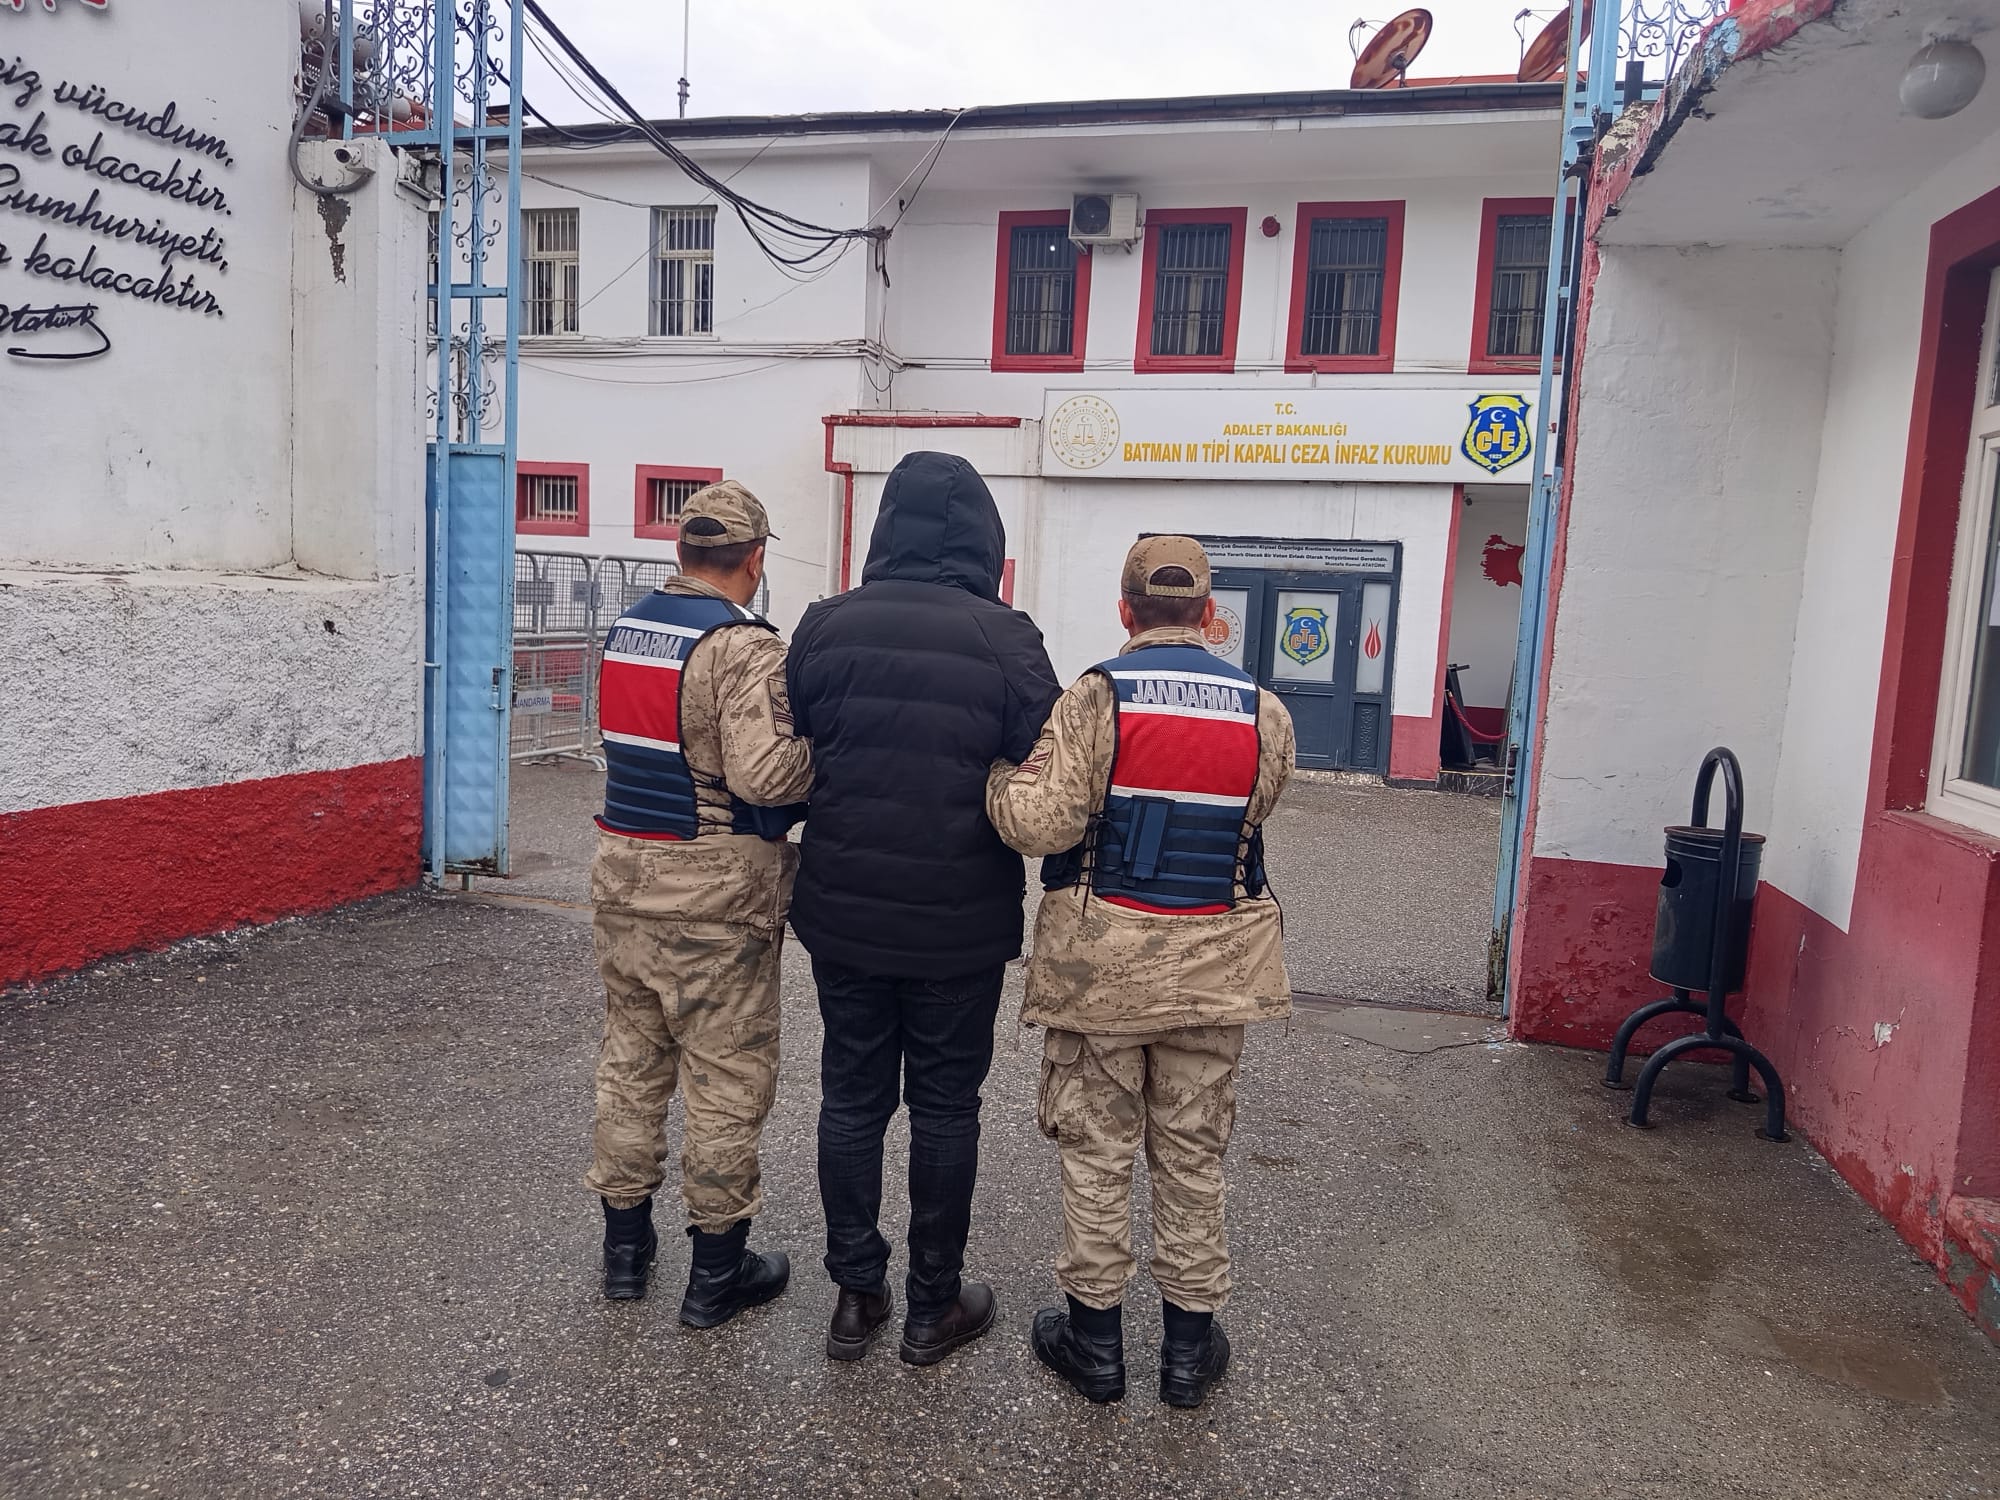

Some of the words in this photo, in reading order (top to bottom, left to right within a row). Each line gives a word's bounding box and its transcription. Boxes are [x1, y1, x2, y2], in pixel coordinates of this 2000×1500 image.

[54, 80, 234, 167] vücudum,
[62, 131, 232, 216] olacaktır.
[24, 232, 224, 317] kalacaktır.
[1275, 403, 1297, 415] T.C.
[1223, 424, 1272, 436] ADALET
[1276, 422, 1347, 436] BAKANLIĞI
[1123, 442, 1182, 462] BATMAN
[1186, 443, 1198, 463] M
[1202, 439, 1230, 463] TİPİ
[1234, 443, 1287, 464] KAPALI
[1291, 444, 1330, 464] CEZA
[1335, 440, 1379, 464] İNFAZ
[1383, 444, 1453, 465] KURUMU
[610, 628, 683, 660] JANDARMA
[1132, 680, 1244, 713] JANDARMA
